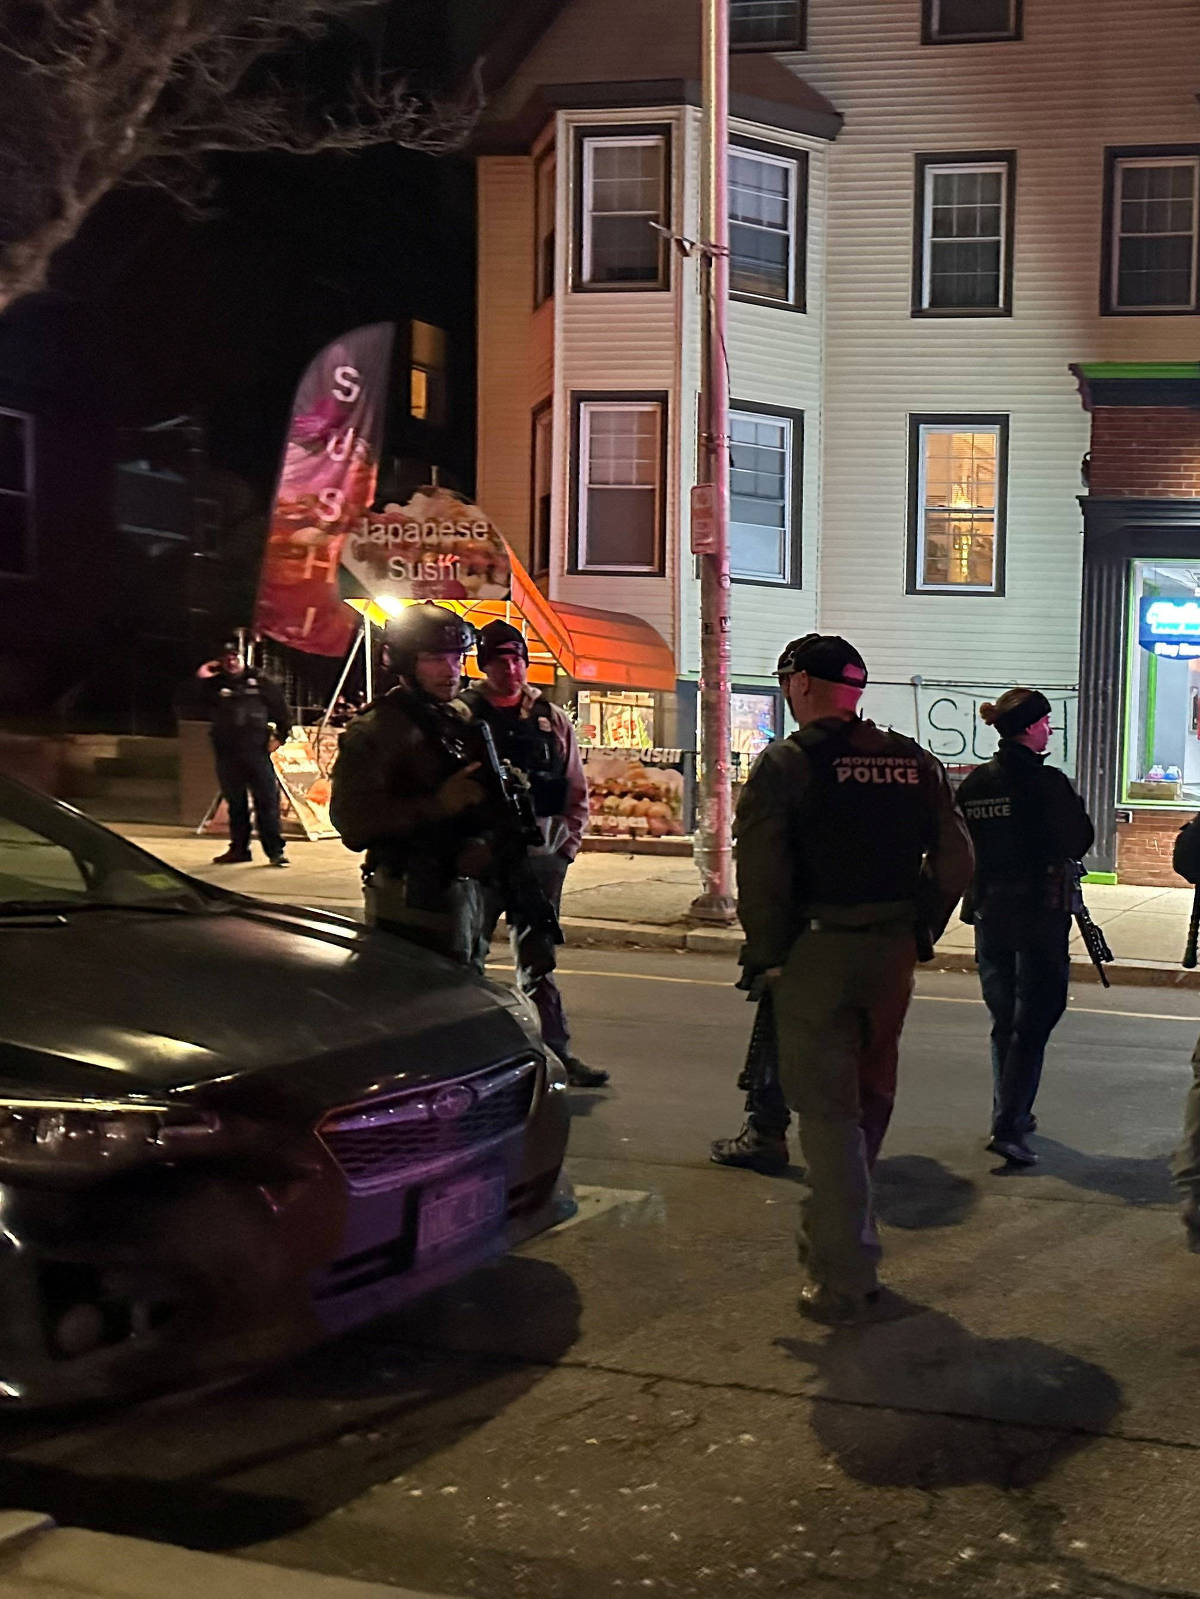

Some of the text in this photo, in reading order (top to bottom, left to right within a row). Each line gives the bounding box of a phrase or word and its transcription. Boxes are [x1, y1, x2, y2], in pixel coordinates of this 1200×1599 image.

[355, 517, 489, 549] Japanese
[388, 555, 461, 583] Sushi
[928, 698, 1067, 763] SUH
[837, 767, 919, 785] POLICE
[966, 804, 1012, 819] POLICE
